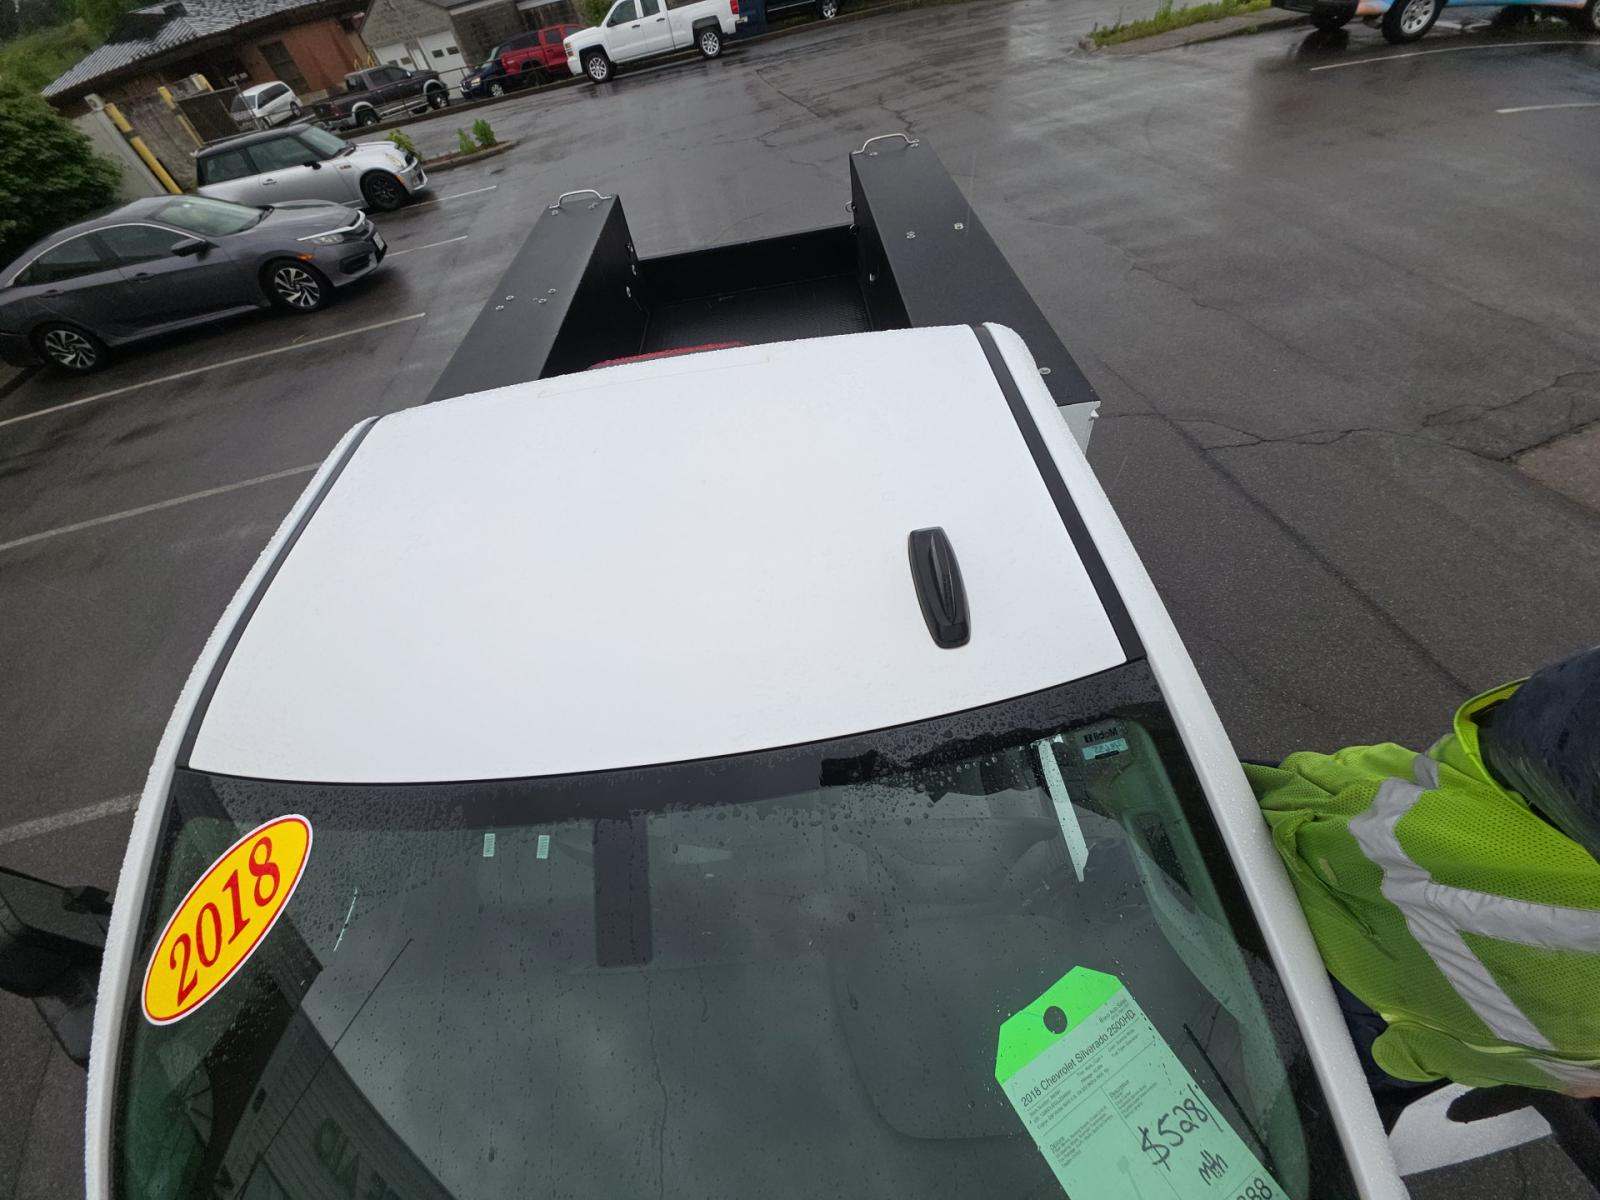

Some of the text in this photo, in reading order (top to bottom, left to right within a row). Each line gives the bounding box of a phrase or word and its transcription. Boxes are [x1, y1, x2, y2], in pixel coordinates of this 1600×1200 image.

[169, 836, 281, 1007] 2018
[1021, 1086, 1042, 1107] 2018
[1040, 1058, 1077, 1090] Chevrolet
[1075, 1033, 1109, 1064] Silverado
